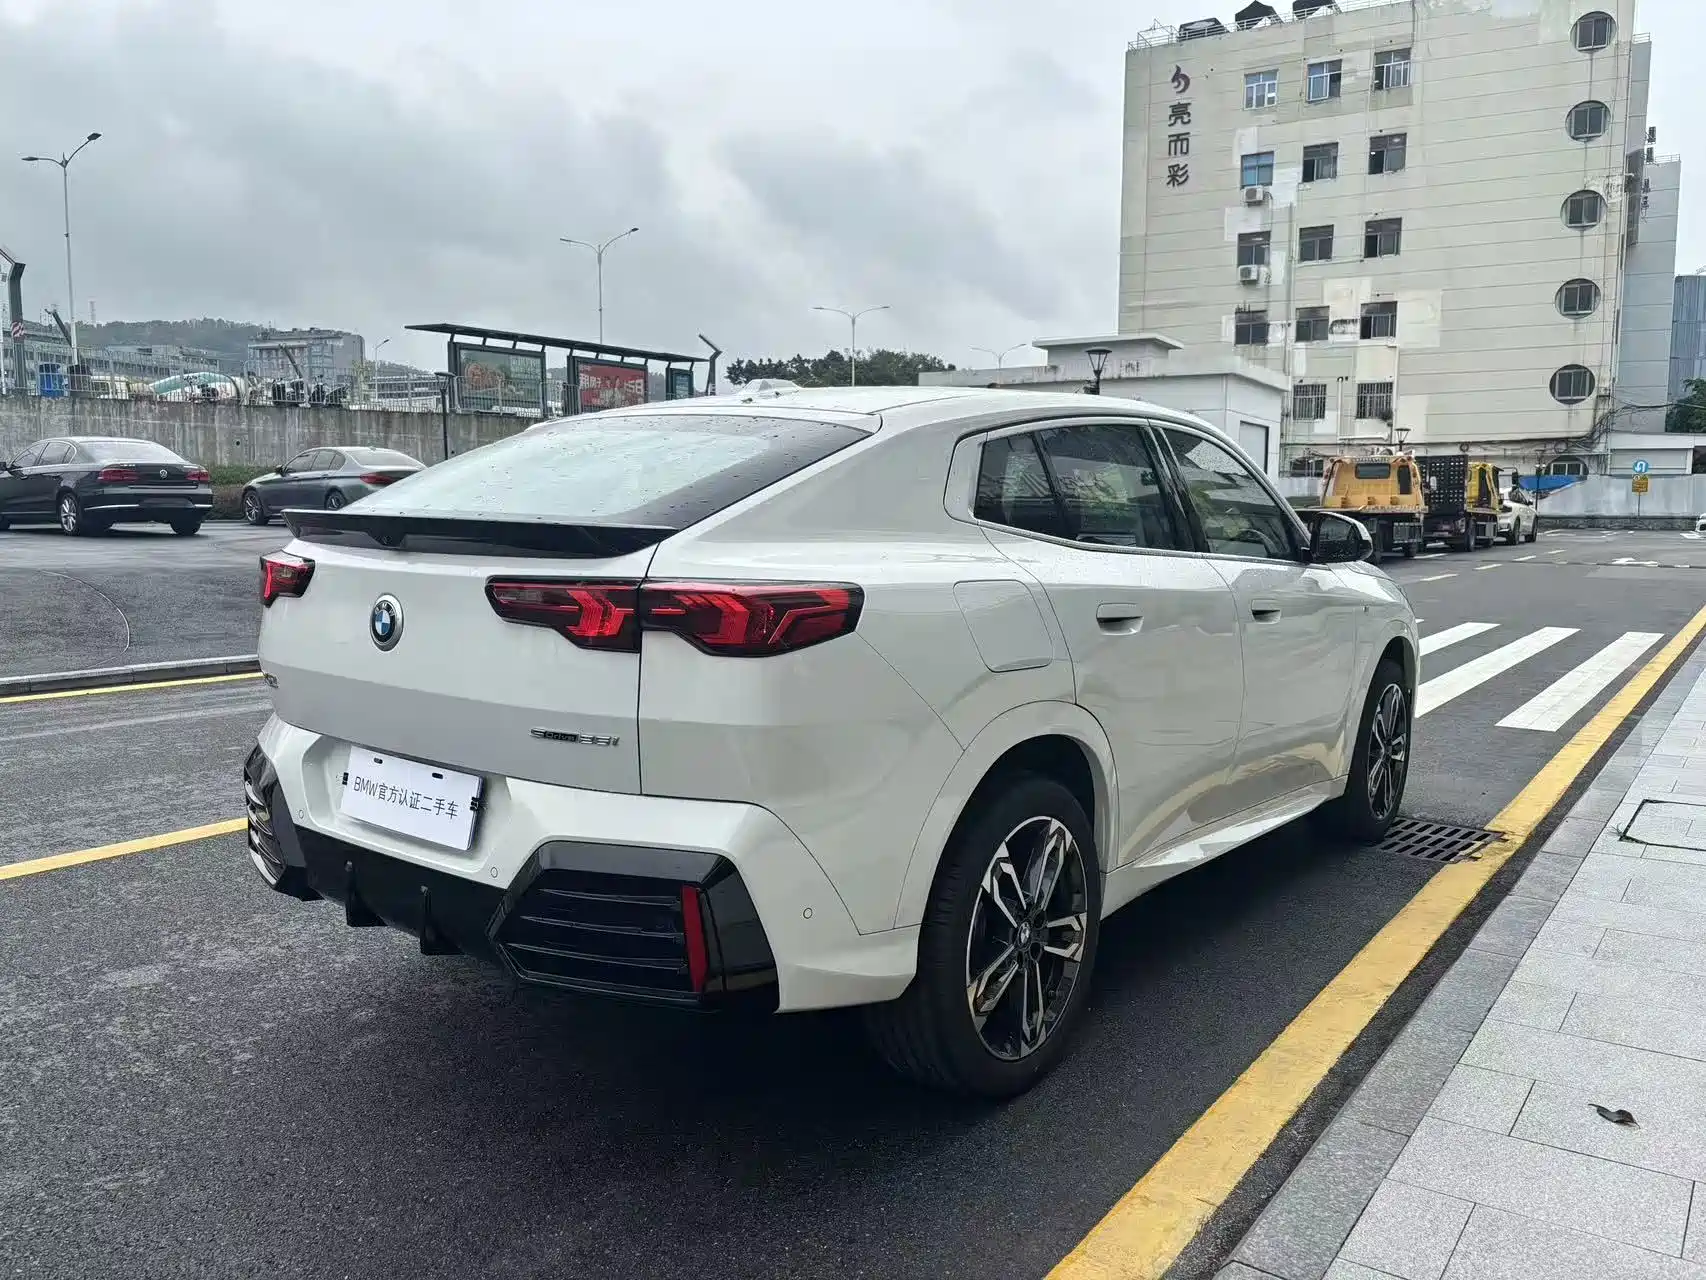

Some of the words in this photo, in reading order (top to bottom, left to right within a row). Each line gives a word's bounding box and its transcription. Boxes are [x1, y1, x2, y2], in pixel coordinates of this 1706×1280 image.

[1166, 101, 1192, 188] 亮而彩
[353, 775, 459, 820] BMW官方认证二手车
